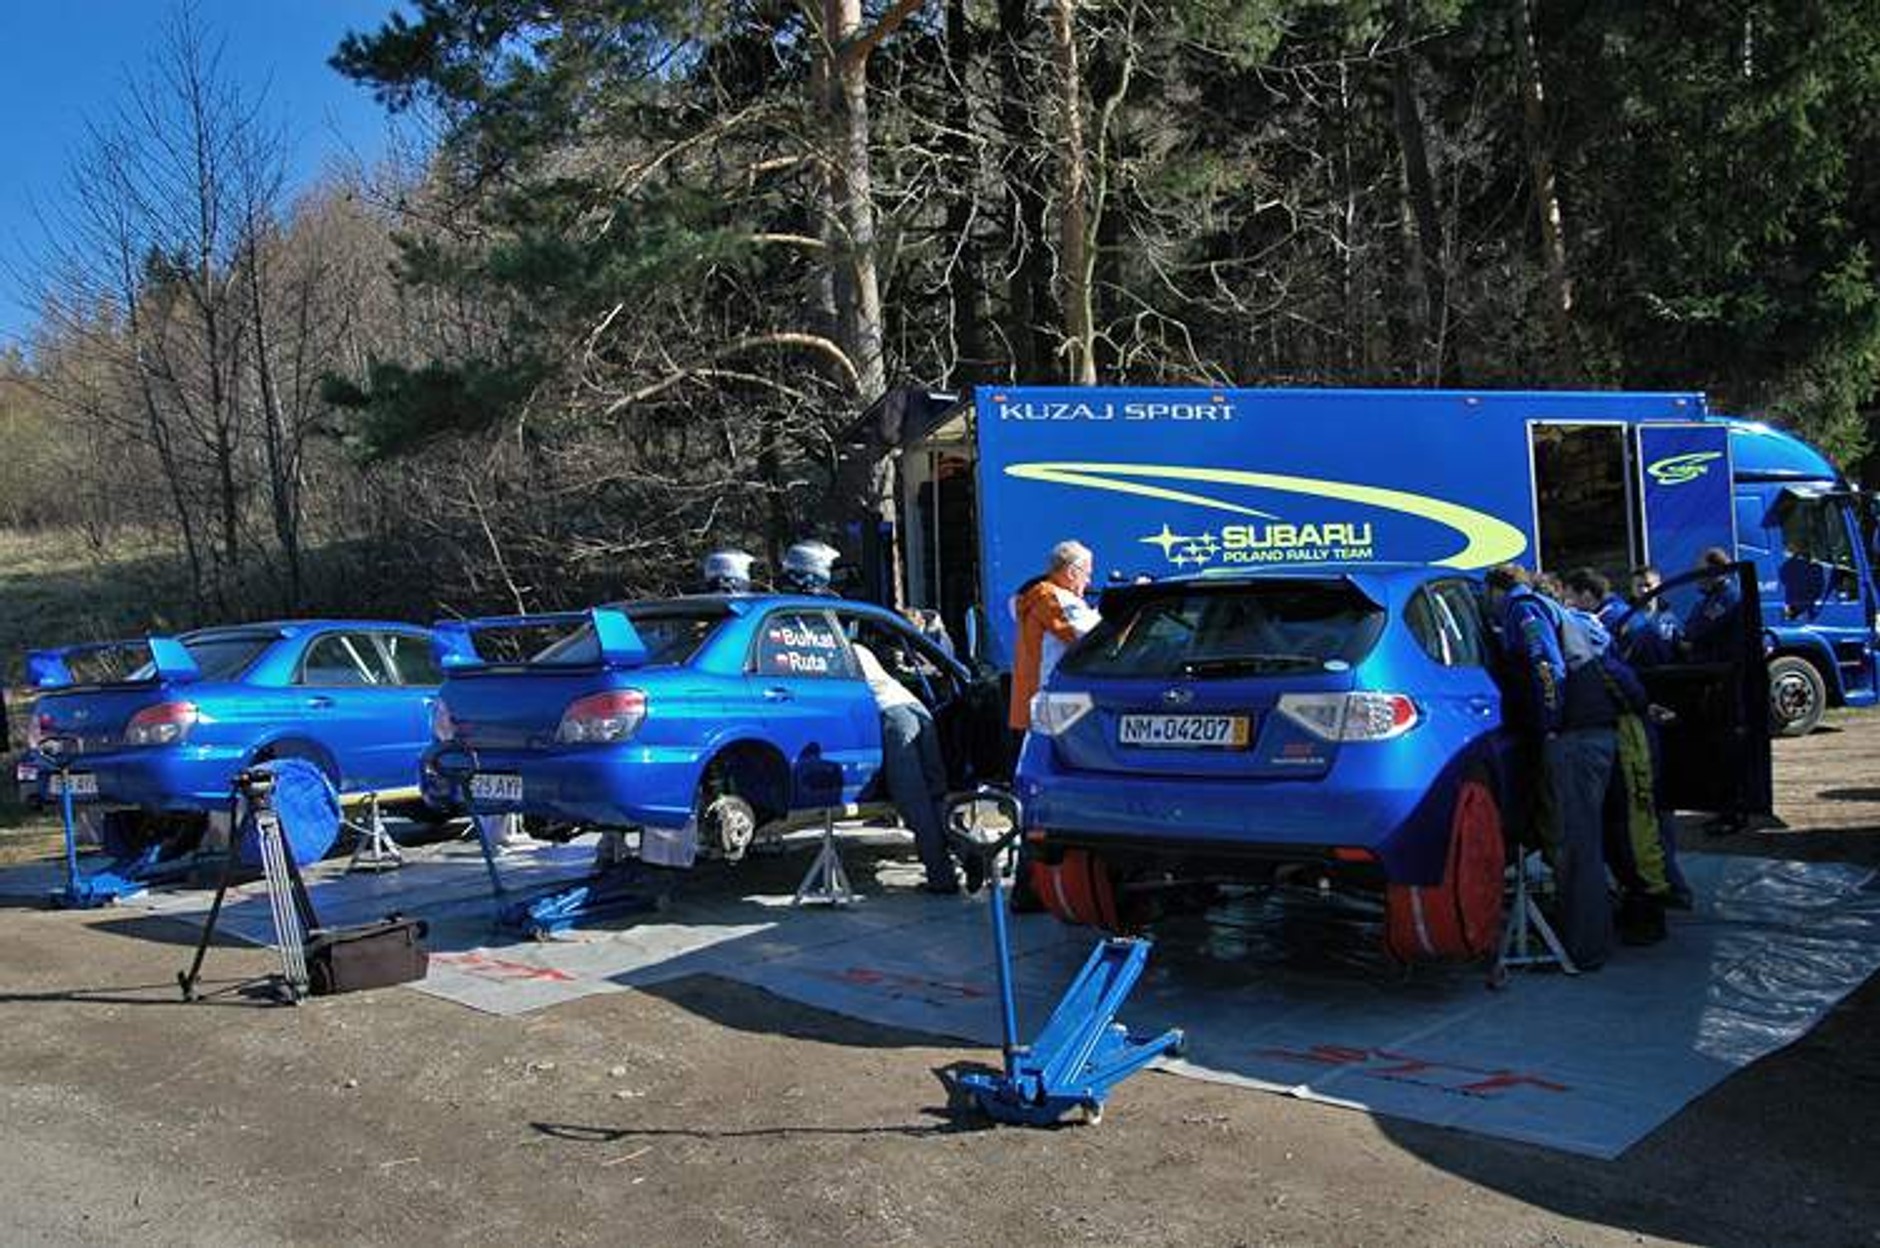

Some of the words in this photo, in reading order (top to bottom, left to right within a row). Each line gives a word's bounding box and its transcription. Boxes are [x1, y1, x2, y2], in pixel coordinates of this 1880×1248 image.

[999, 403, 1114, 420] KUZAJ
[1124, 403, 1237, 420] SPORT
[1221, 523, 1372, 549] SUBARU
[1223, 551, 1284, 562] POLAND
[1286, 549, 1329, 561] RALLY
[1334, 547, 1373, 559] TEAM
